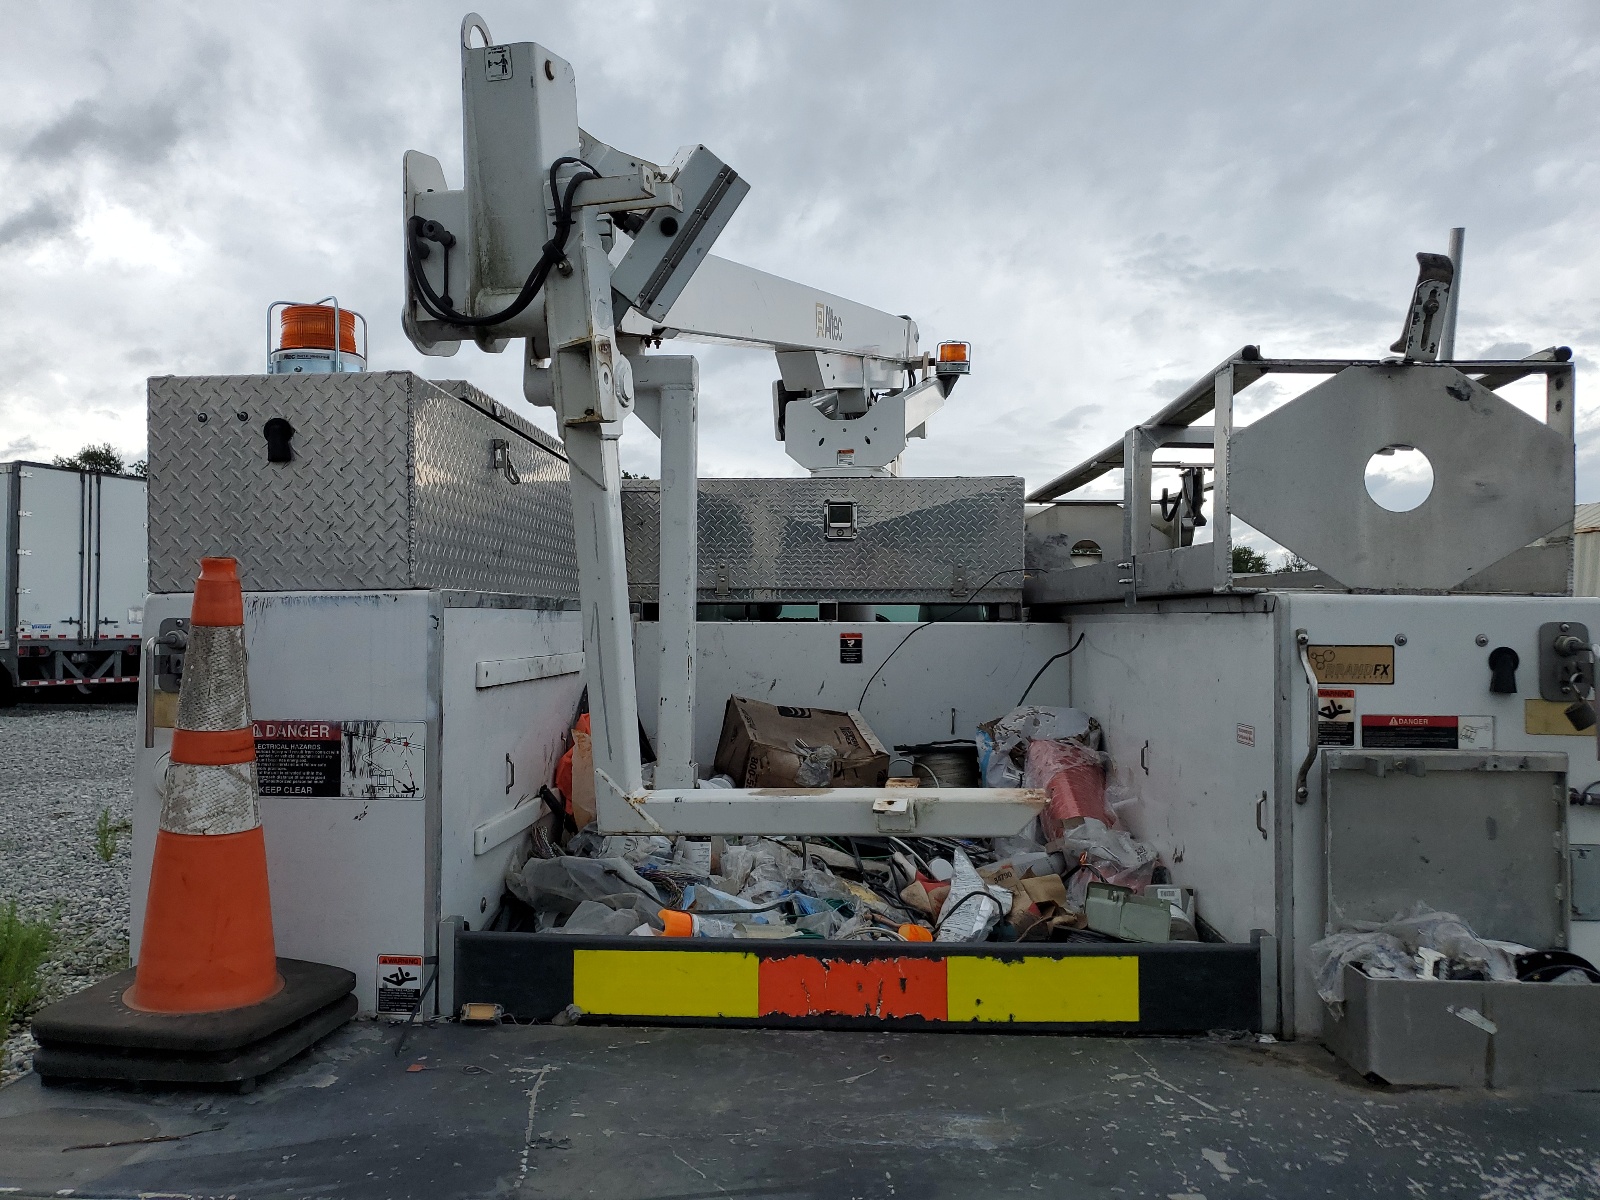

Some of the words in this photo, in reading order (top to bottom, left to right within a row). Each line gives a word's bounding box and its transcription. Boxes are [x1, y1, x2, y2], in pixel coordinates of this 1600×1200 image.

[825, 305, 843, 342] Altec
[265, 724, 330, 738] DANGER
[259, 786, 282, 794] KEEP
[283, 786, 313, 794] CLEAR
[993, 871, 1013, 884] 34790
